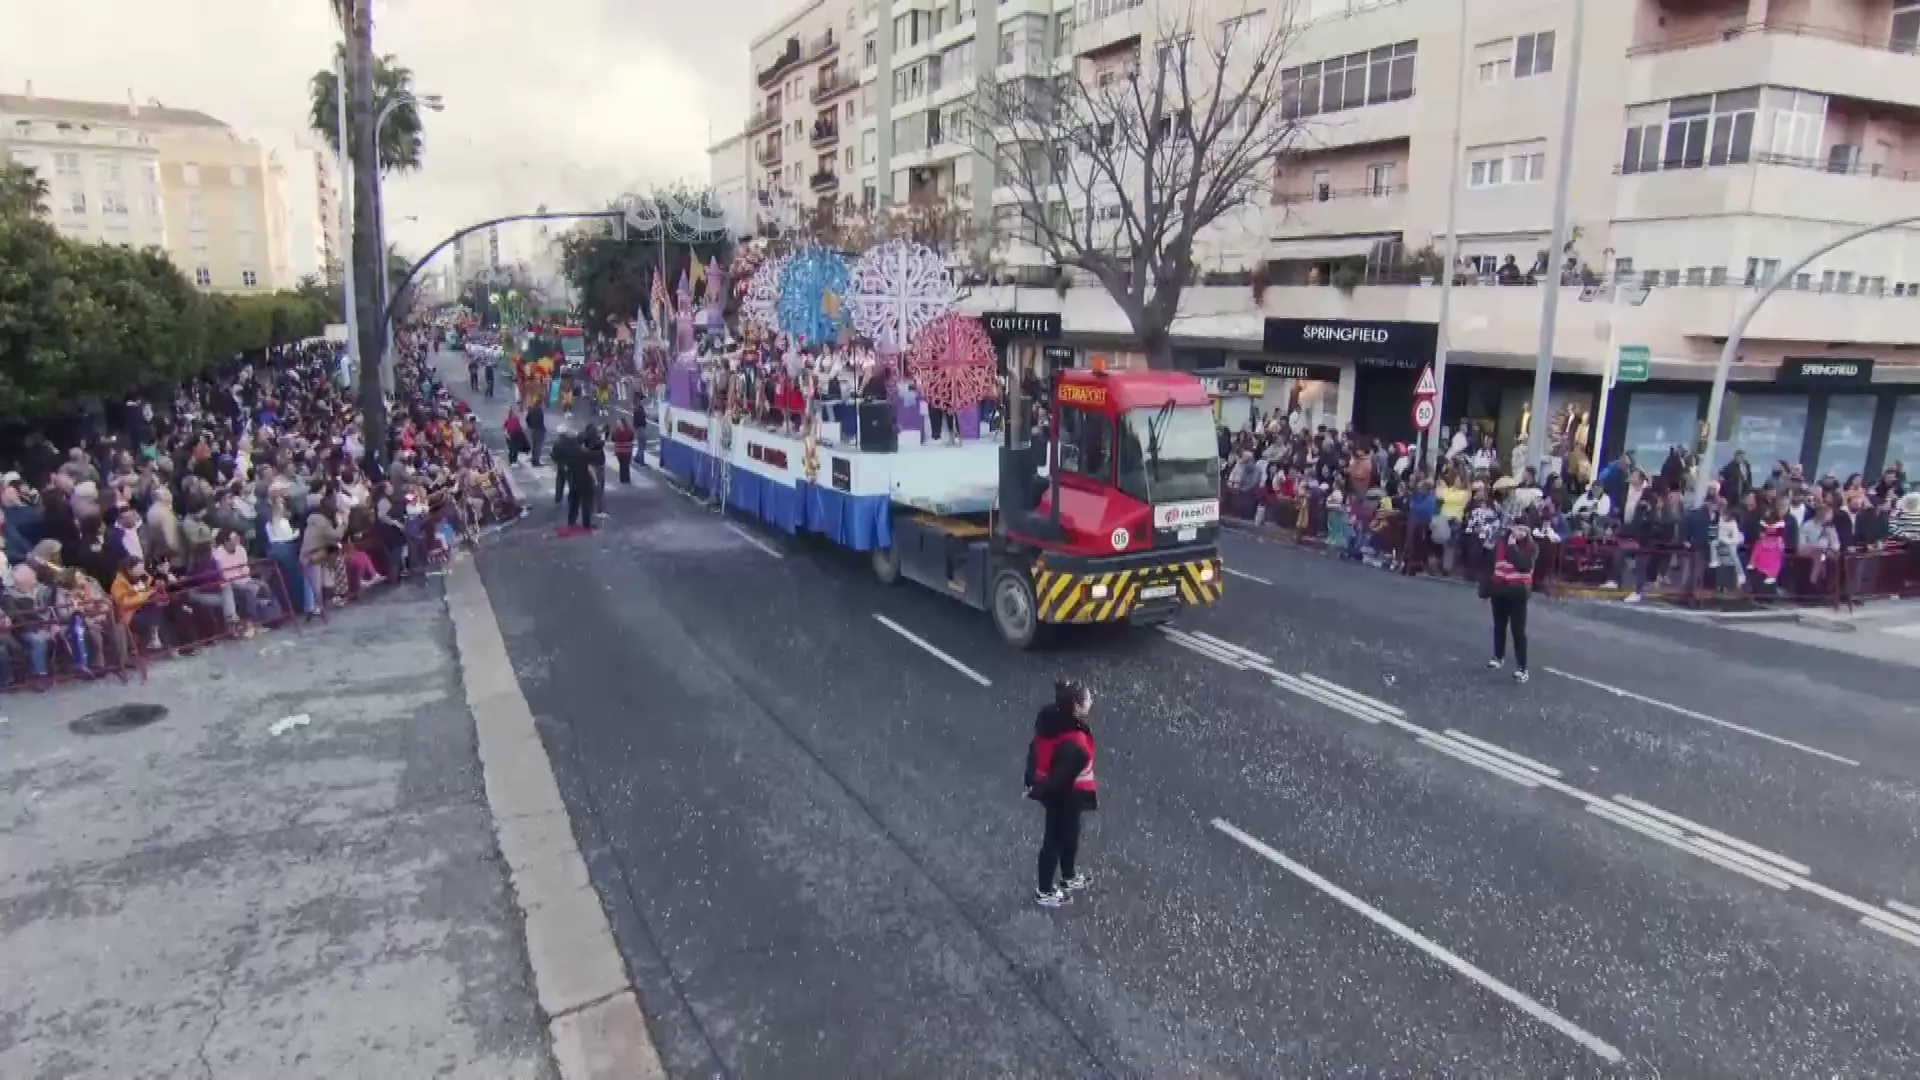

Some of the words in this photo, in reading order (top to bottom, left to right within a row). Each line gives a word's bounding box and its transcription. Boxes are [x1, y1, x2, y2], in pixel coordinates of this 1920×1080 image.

[990, 317, 1049, 332] CORTEFIEL
[1303, 325, 1389, 343] SPRINGFIELD
[1265, 364, 1308, 377] CORTEFIEL
